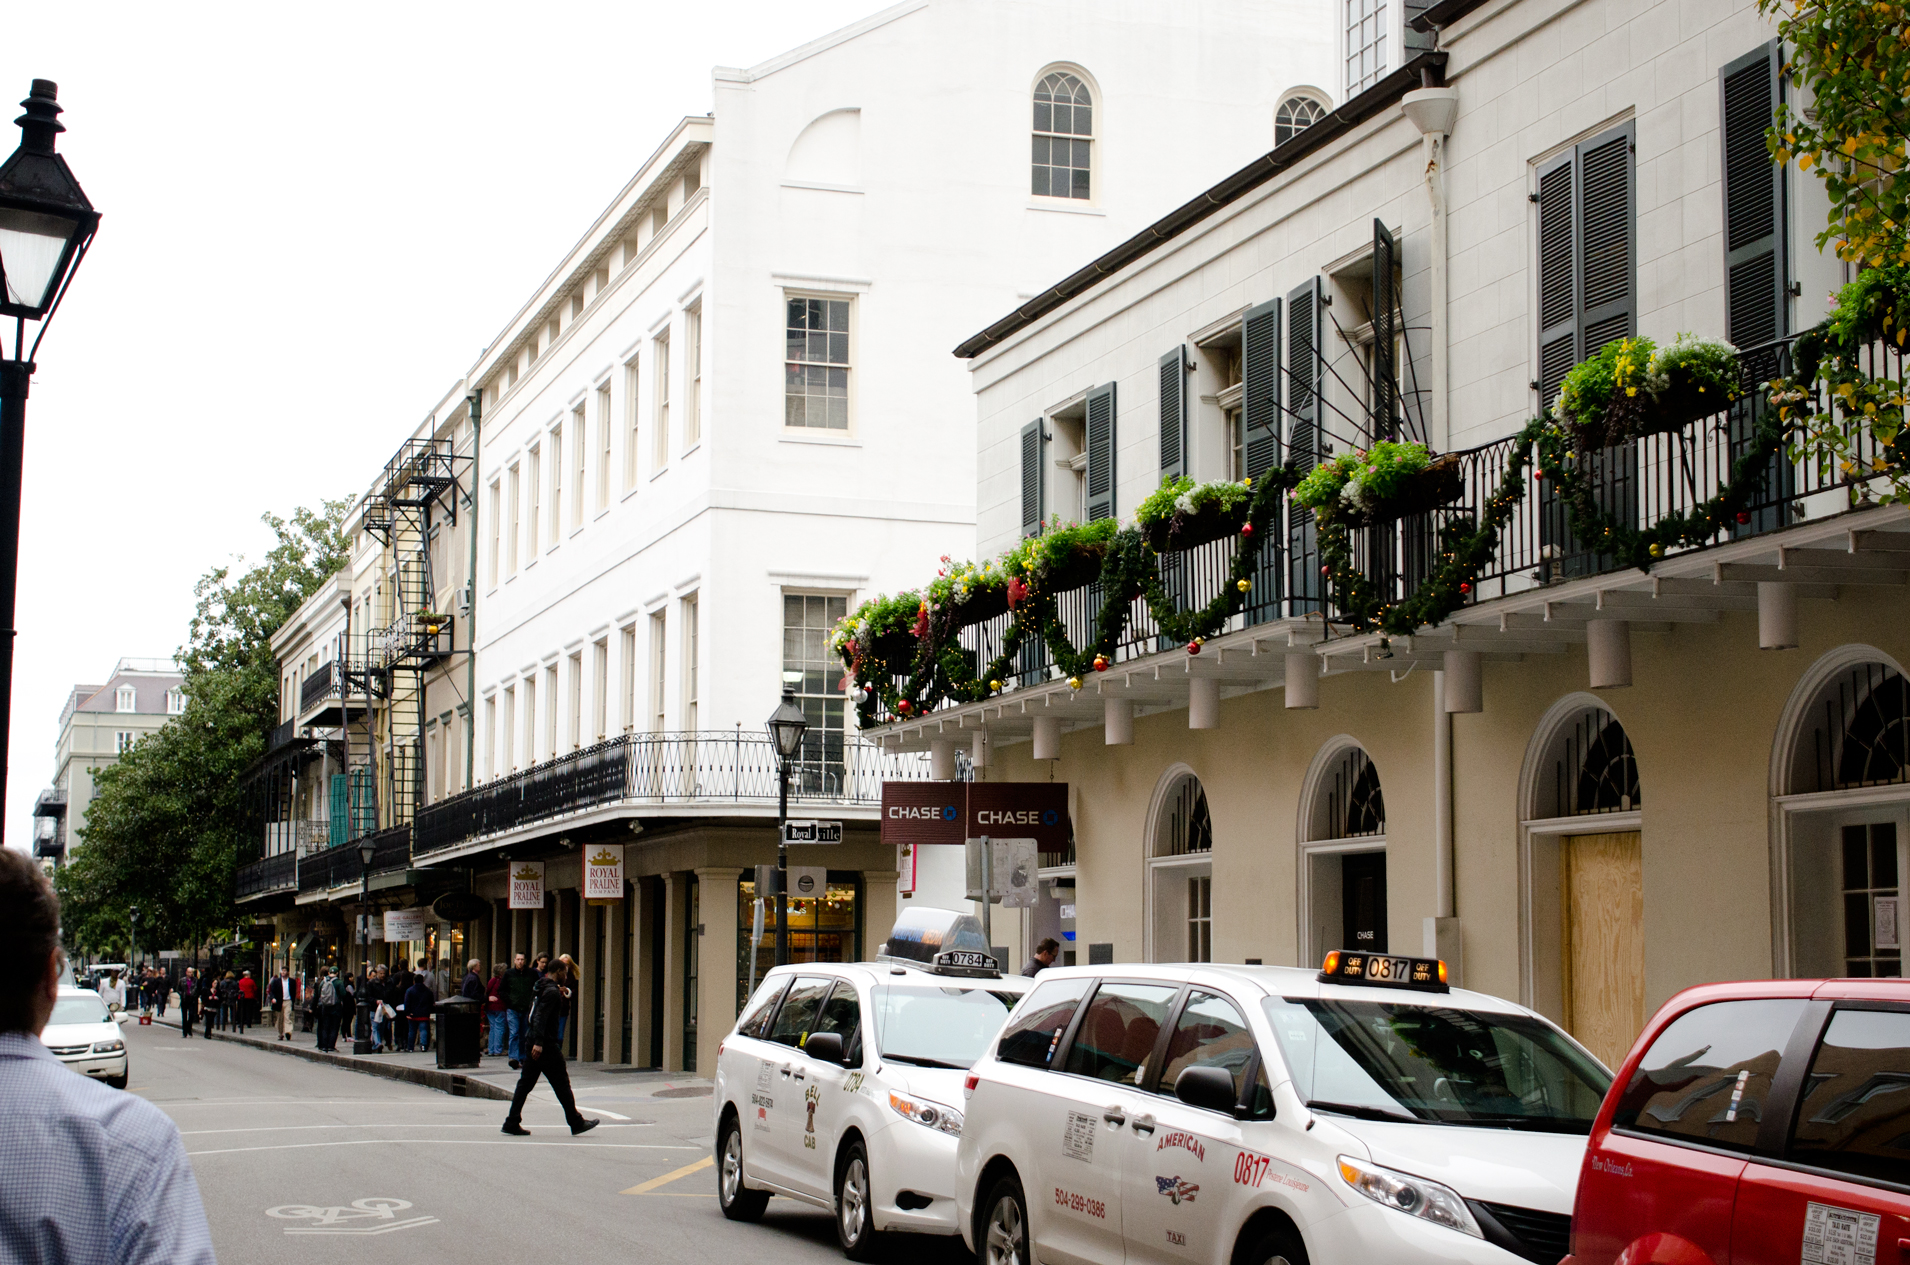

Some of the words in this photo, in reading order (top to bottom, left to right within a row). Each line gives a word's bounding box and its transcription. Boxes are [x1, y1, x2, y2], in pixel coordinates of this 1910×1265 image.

[889, 806, 940, 819] CHASE
[977, 811, 1039, 825] CHASE
[791, 828, 811, 840] Royal
[590, 868, 619, 878] ROYAL
[514, 882, 540, 891] ROYAL
[589, 879, 620, 889] PRALINE
[513, 891, 540, 900] PRALINE
[1357, 931, 1374, 940] CHASE
[953, 953, 982, 966] 0784
[1348, 957, 1362, 966] OFF
[1344, 966, 1362, 975] DUTY
[1368, 957, 1409, 980] 0817
[1416, 963, 1430, 972] OFF
[1413, 972, 1431, 981] DUTY
[843, 1071, 865, 1093] 0784
[805, 1085, 820, 1107] BELL
[804, 1134, 816, 1150] CAB
[1156, 1132, 1206, 1163] AMERICAN
[1592, 1155, 1604, 1170] New
[1233, 1151, 1270, 1188] 0817
[1055, 1187, 1105, 1219] 504-299-0386
[1167, 1231, 1186, 1245] TAXI
